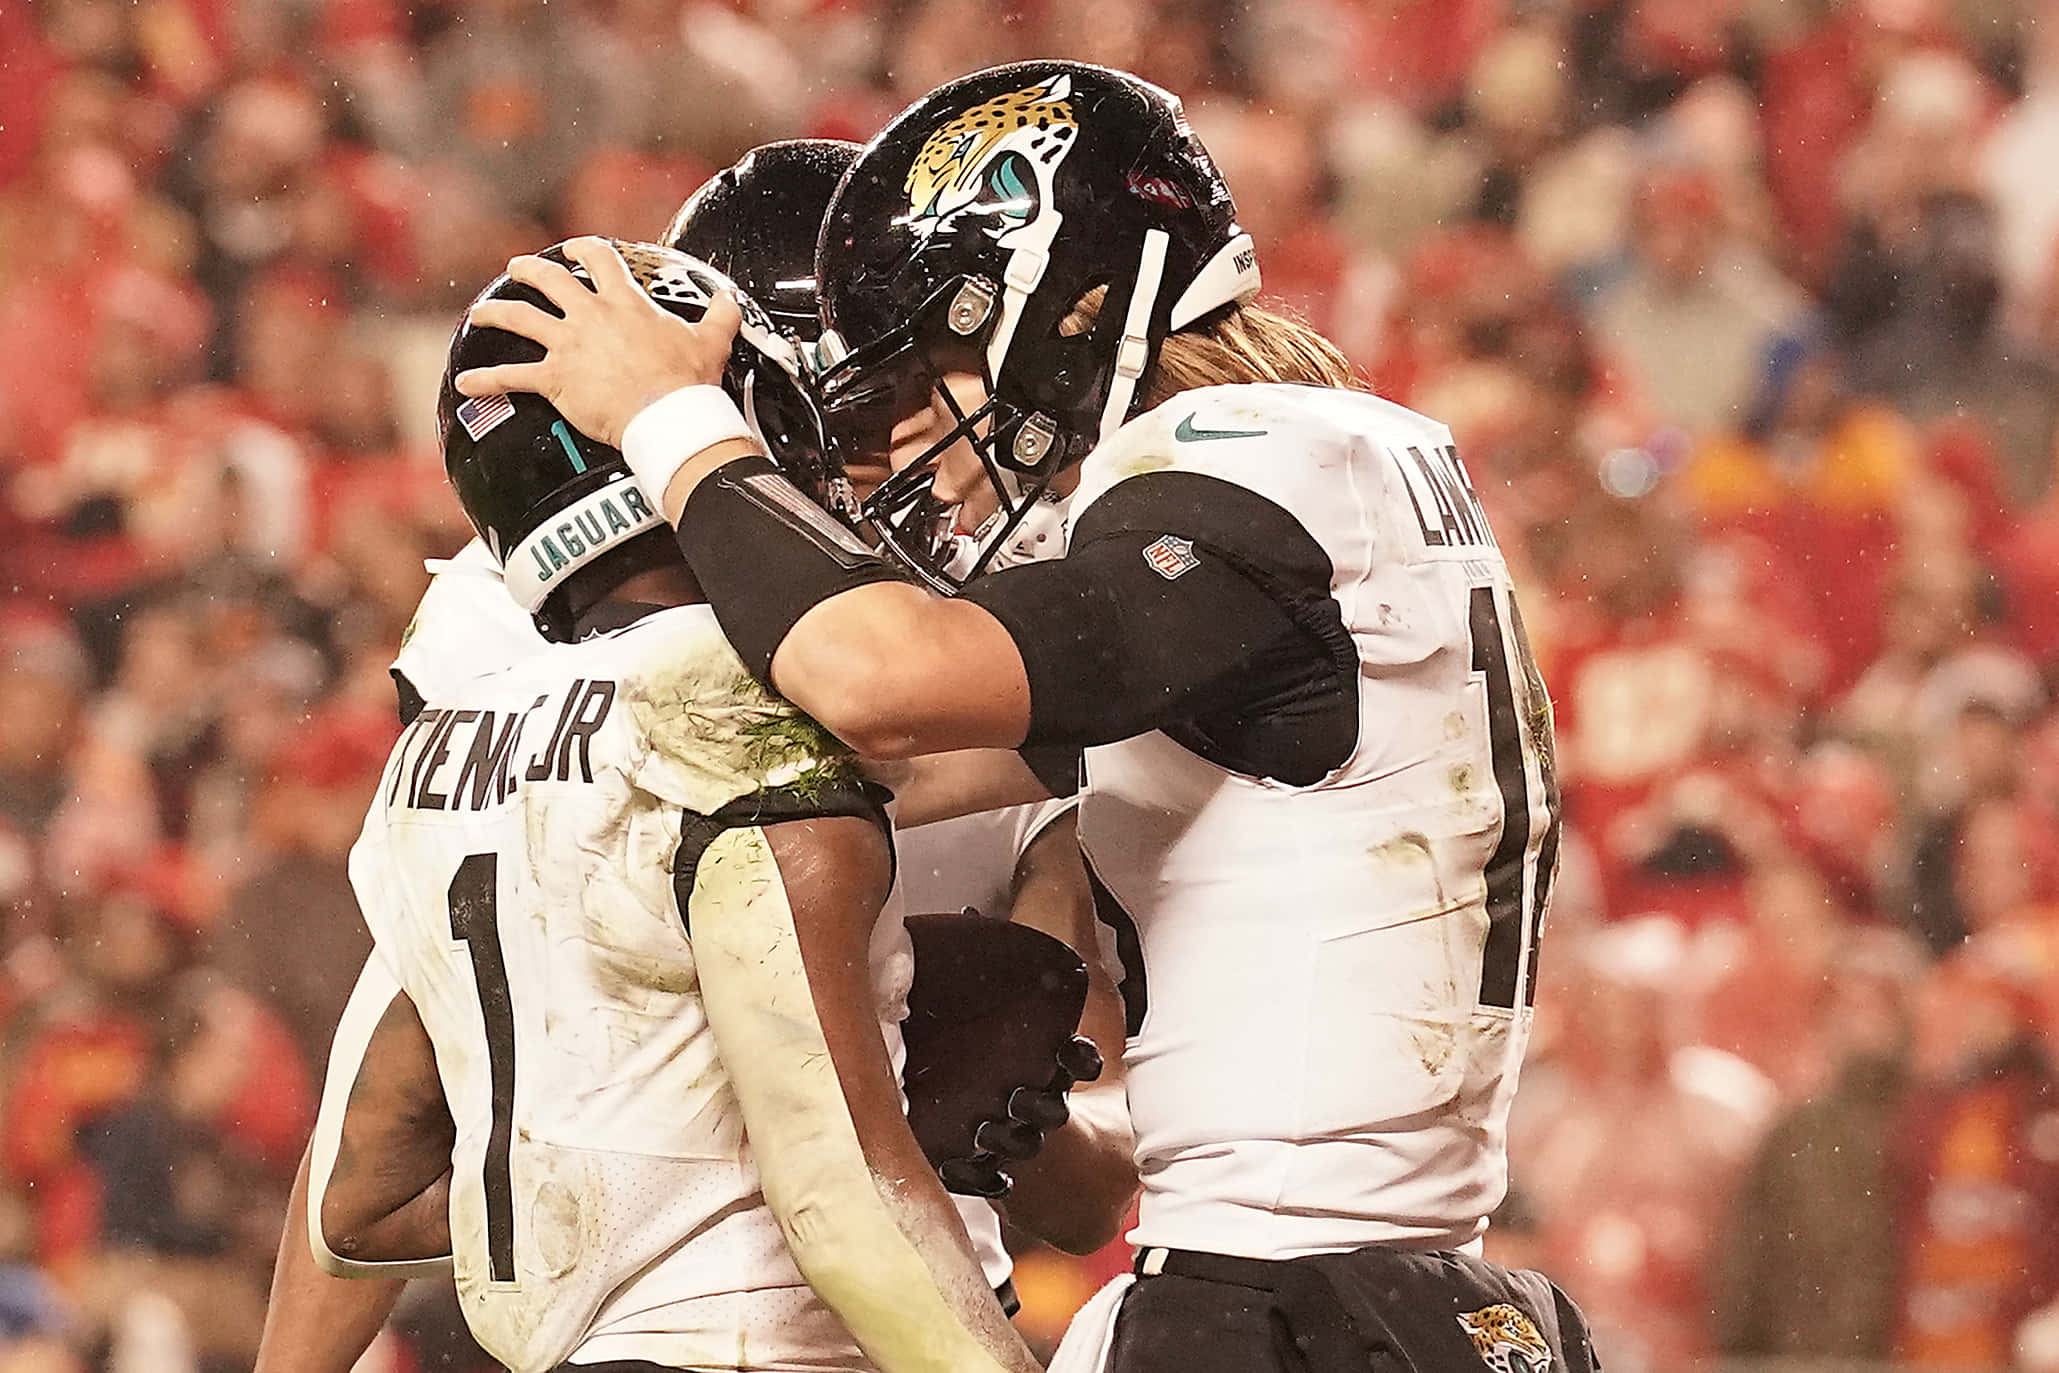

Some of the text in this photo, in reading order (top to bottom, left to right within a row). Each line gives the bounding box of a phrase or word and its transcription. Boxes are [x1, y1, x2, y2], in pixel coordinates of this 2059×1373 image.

[551, 420, 586, 474] 1
[1149, 544, 1181, 574] NFL
[525, 678, 616, 783] JR
[447, 852, 517, 1282] 1
